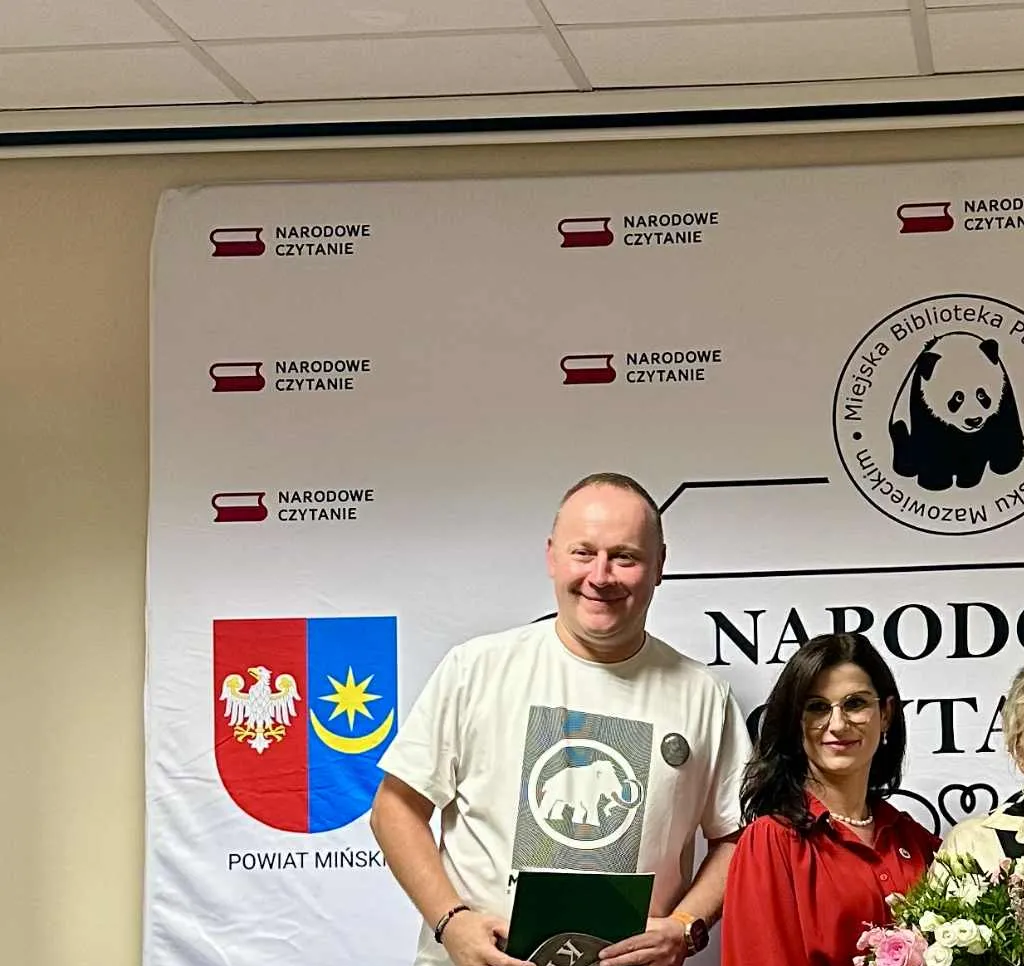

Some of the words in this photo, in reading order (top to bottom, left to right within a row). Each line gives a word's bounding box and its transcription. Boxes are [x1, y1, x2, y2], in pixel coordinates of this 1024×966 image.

[624, 212, 718, 228] NARODOWE
[276, 225, 370, 238] NARODOWE
[624, 231, 702, 245] CZYTANIE
[276, 243, 353, 256] CZYTANIE
[890, 304, 1004, 341] Biblioteka
[627, 350, 721, 365] NARODOWE
[276, 360, 370, 374] NARODOWE
[627, 369, 704, 383] CZYTANIE
[844, 342, 890, 421] Miejska
[275, 378, 353, 391] CZYTANIE
[856, 449, 988, 524] Mazowieckim
[279, 490, 374, 503] NARODOWE
[278, 508, 356, 521] CZYTANIE
[229, 852, 308, 870] POWIAT
